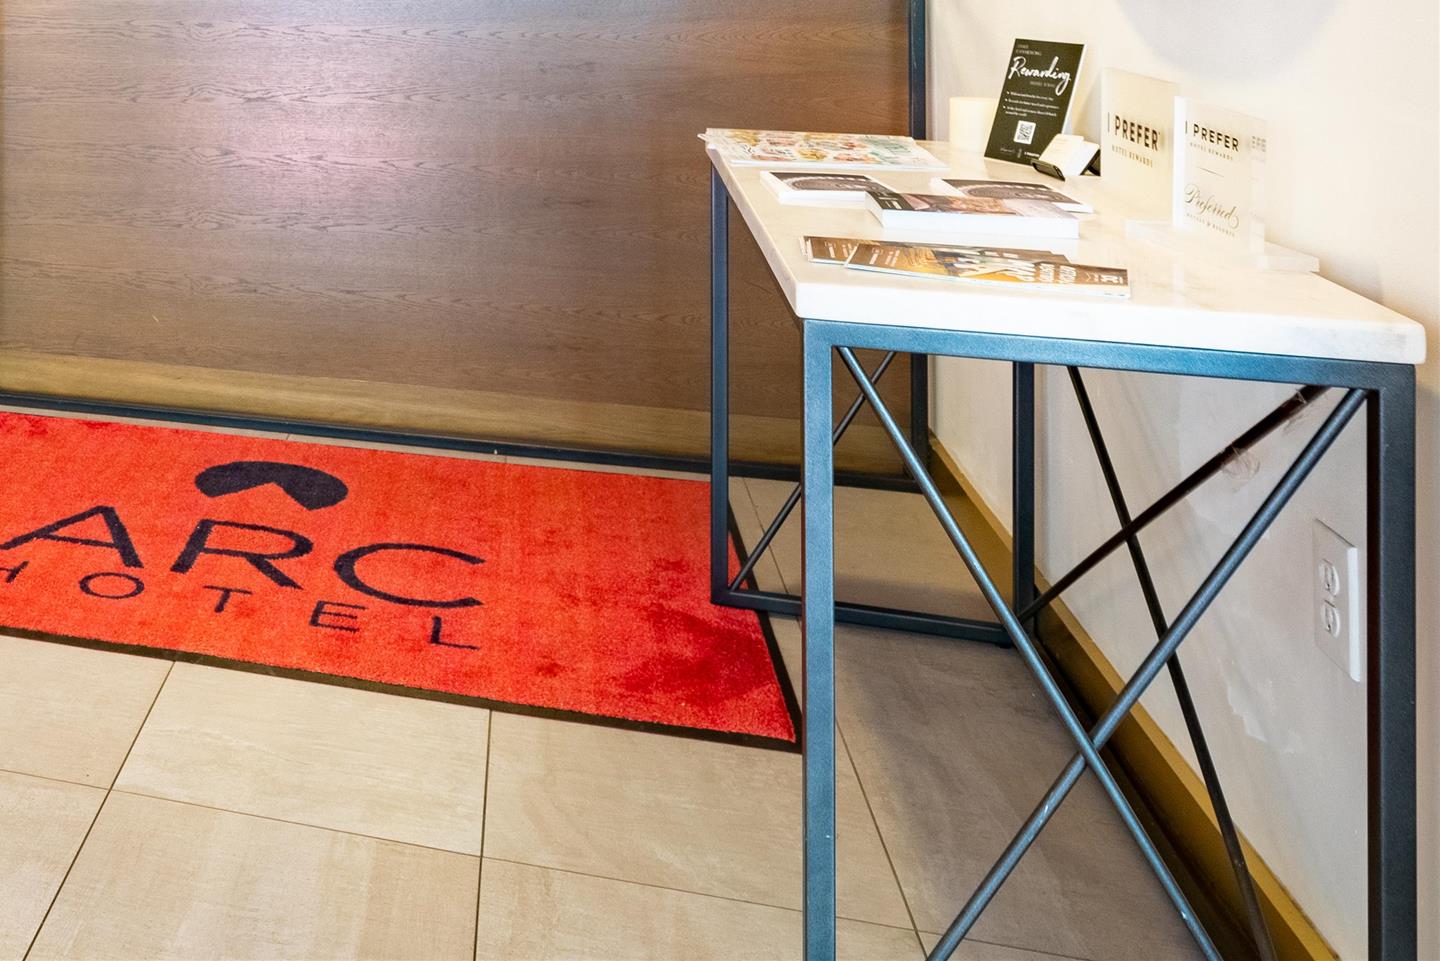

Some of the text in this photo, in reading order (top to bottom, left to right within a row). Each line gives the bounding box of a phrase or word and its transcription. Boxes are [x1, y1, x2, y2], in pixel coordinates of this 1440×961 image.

[1008, 56, 1071, 96] Rewarding
[1115, 115, 1159, 151] PREFER
[1193, 123, 1239, 152] PREFER
[1184, 183, 1240, 230] Preferred
